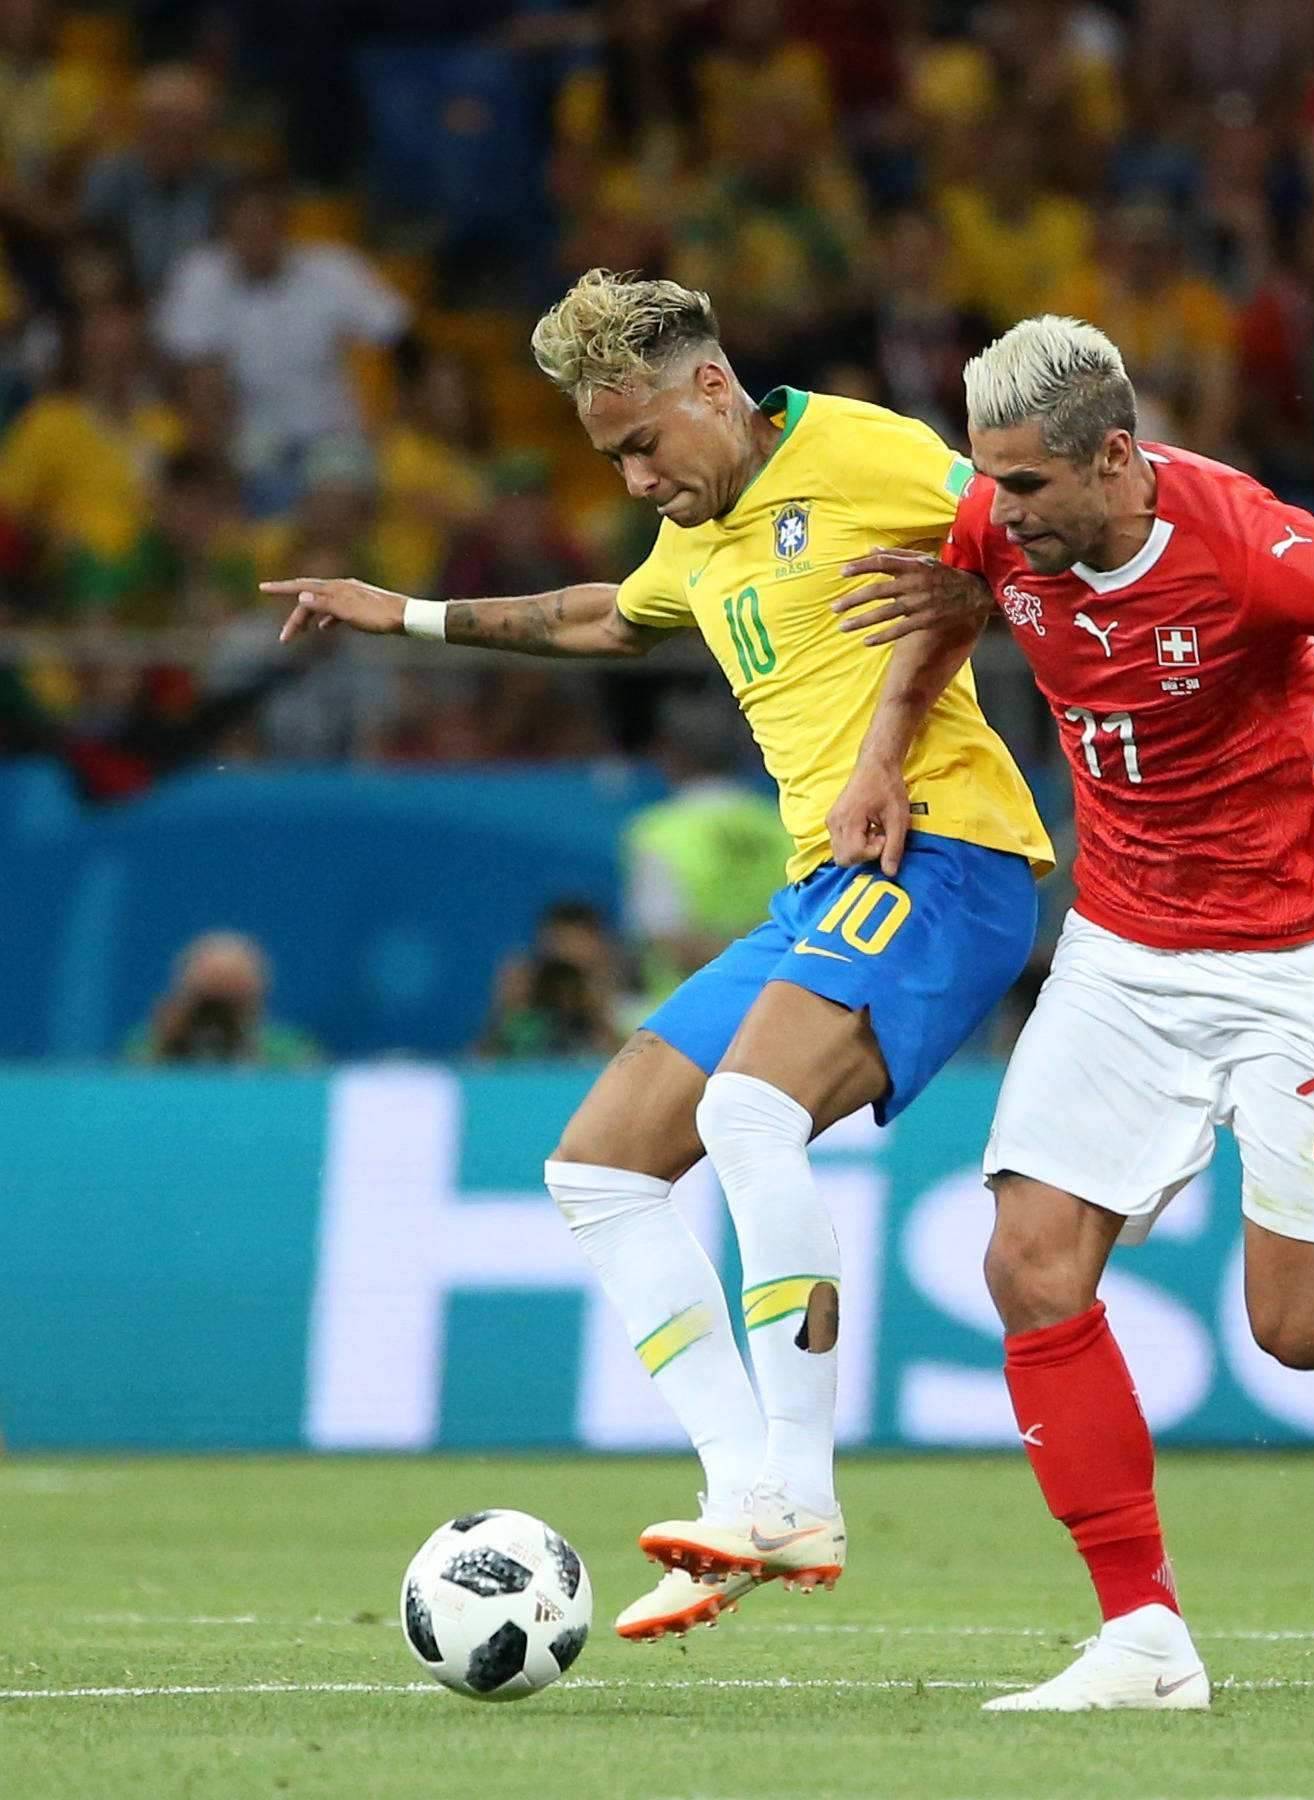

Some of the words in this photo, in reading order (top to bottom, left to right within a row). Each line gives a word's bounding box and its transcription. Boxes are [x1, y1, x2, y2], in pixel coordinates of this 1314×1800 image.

[775, 560, 814, 579] BRASIL
[724, 586, 776, 684] 10
[1065, 706, 1142, 784] 11
[816, 873, 912, 955] 10
